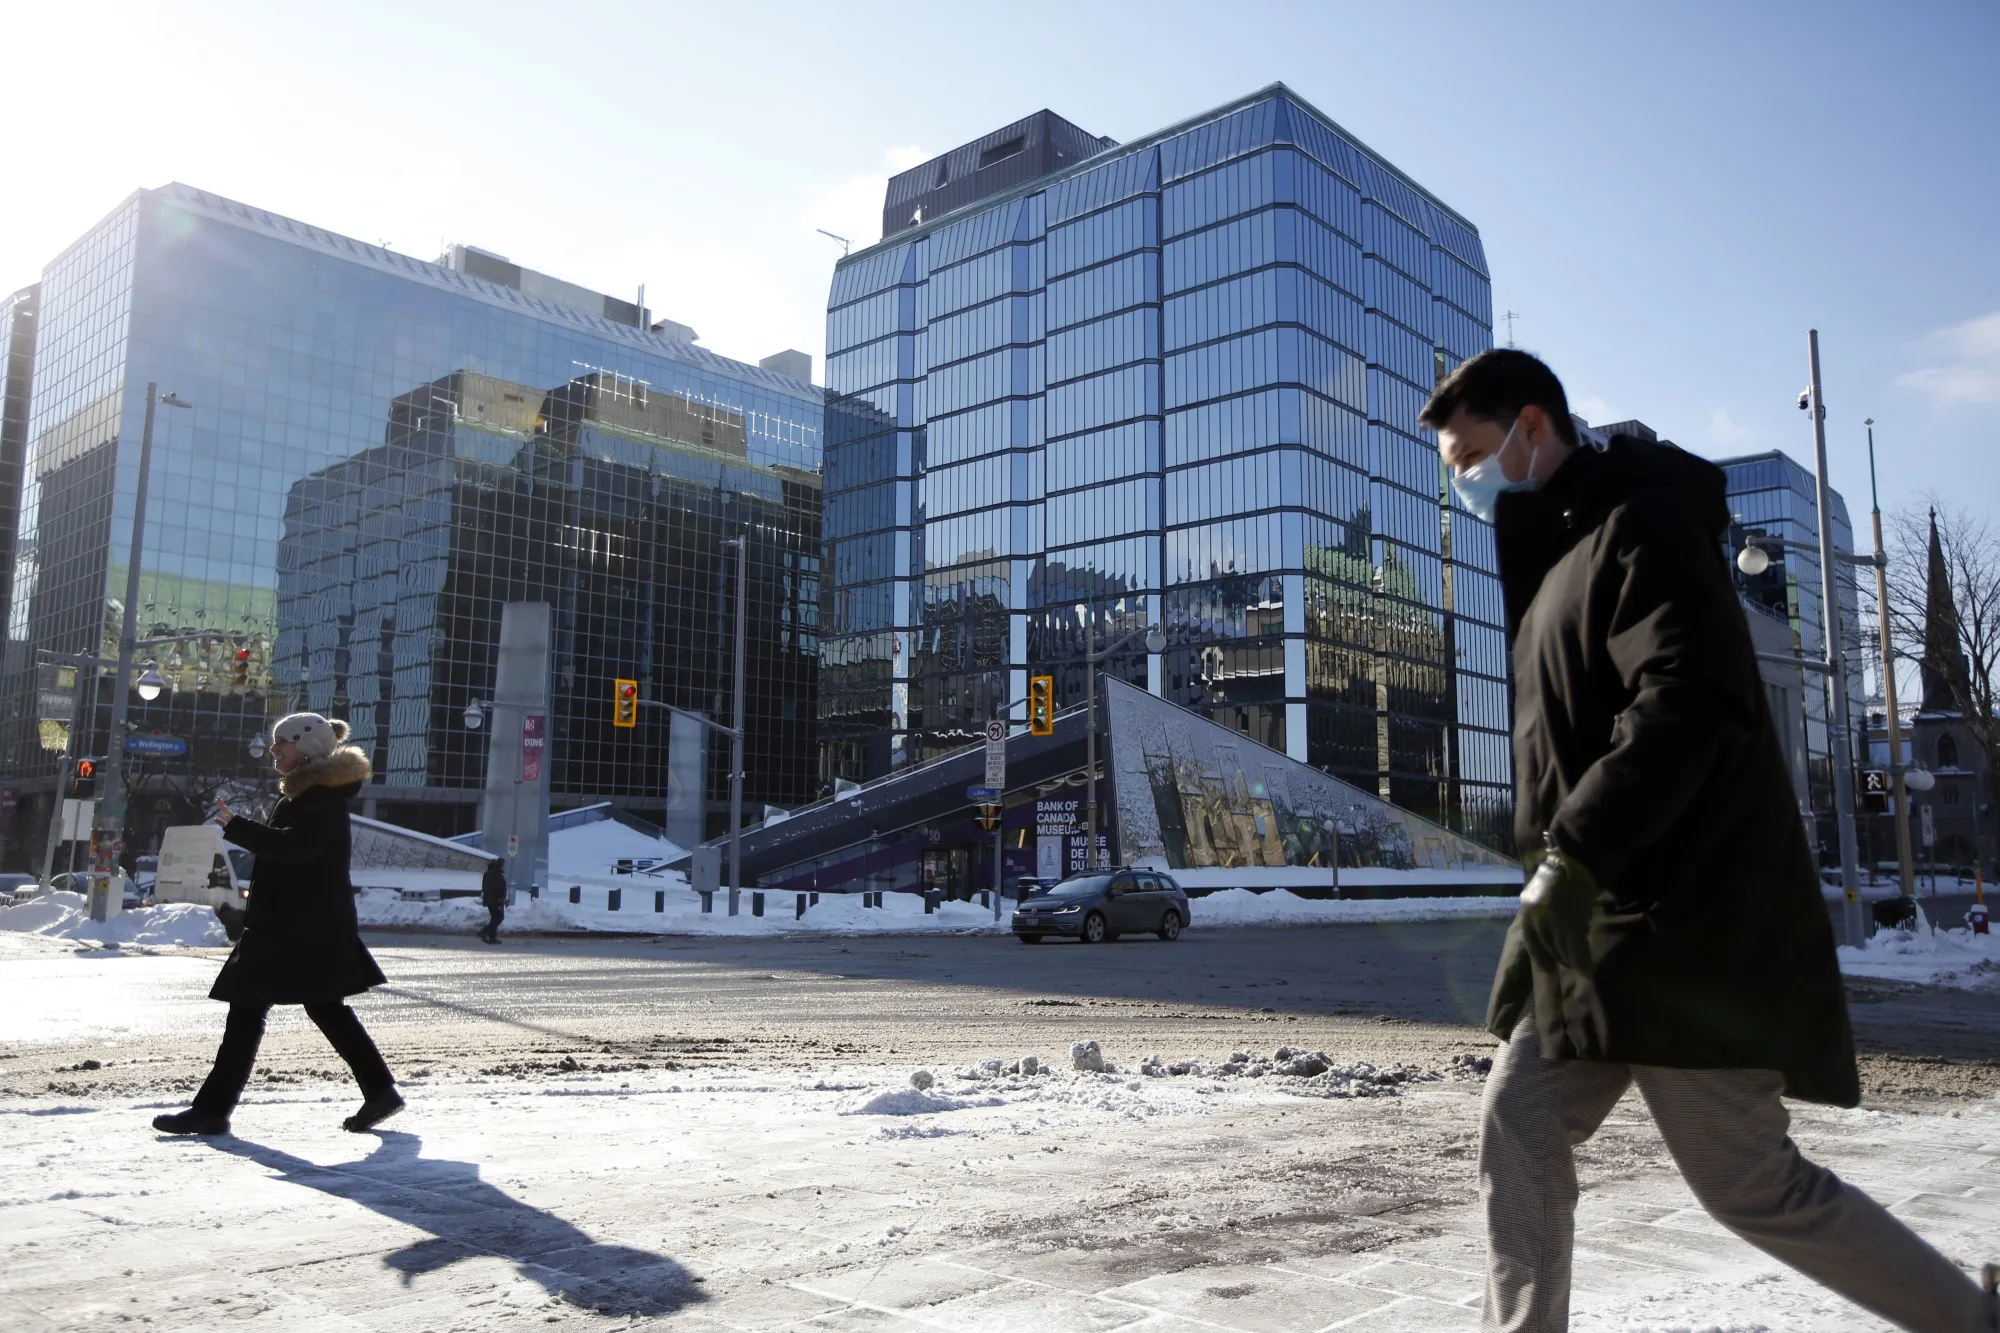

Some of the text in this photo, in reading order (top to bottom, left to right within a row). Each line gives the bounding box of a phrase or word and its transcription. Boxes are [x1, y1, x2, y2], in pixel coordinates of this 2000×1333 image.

[138, 740, 174, 751] Wellington
[524, 738, 544, 747] DINE
[1036, 801, 1078, 812] BANK OF
[1036, 813, 1077, 823] CANADA
[1070, 834, 1107, 847] MUÉE
[1070, 848, 1085, 859] DE
[1070, 860, 1085, 871] DU
